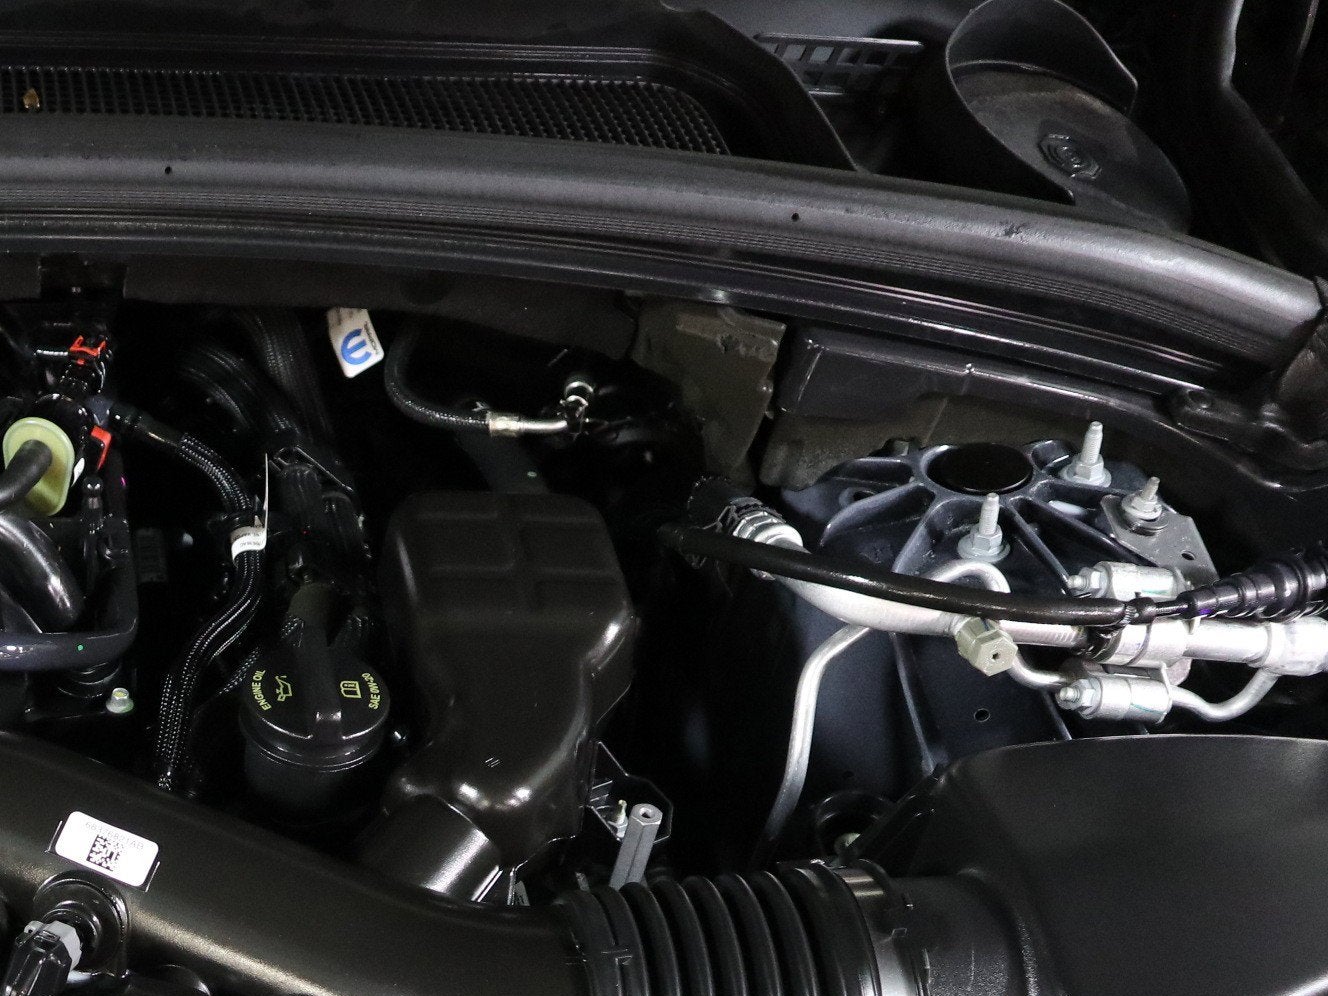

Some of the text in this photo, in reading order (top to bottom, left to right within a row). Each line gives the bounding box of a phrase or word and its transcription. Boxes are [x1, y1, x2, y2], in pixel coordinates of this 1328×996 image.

[251, 669, 272, 711] ENGINE OIL
[361, 672, 381, 710] SAE 0W-20
